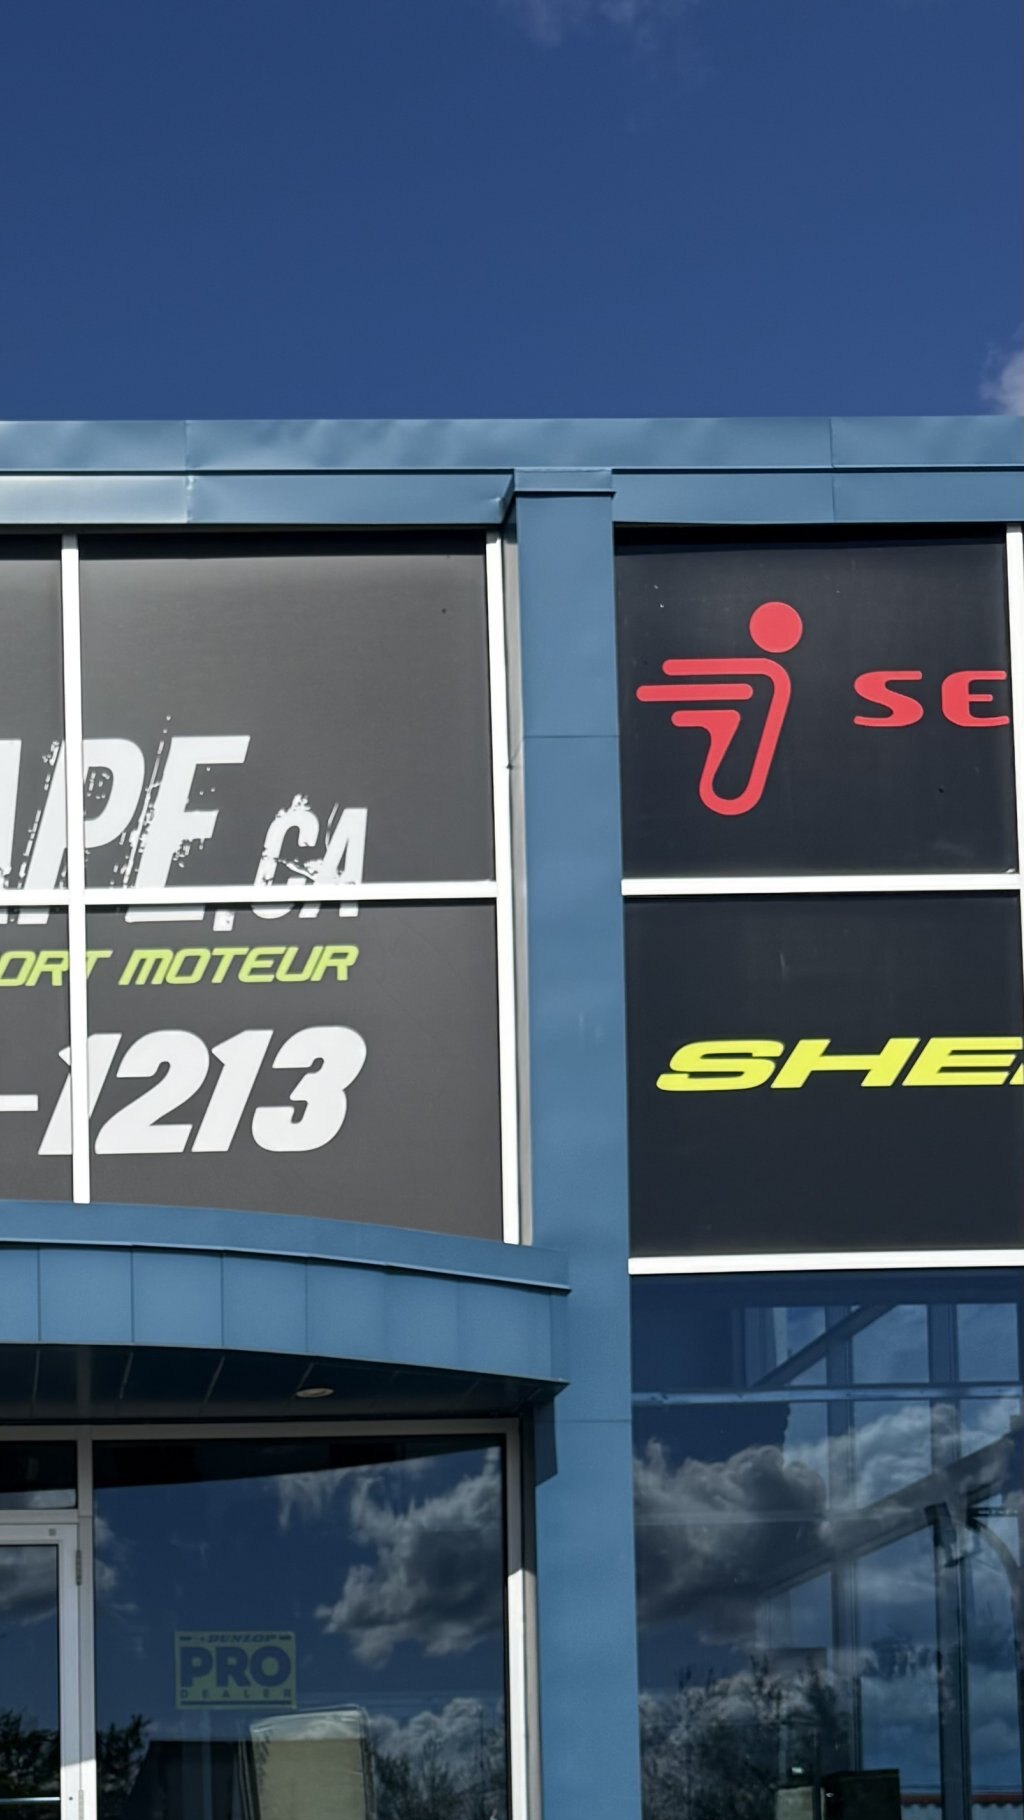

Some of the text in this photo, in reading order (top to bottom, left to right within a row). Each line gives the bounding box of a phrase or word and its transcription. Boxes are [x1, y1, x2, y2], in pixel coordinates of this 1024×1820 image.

[853, 670, 1011, 728] SE
[118, 944, 360, 986] MOTEUR
[656, 1036, 1024, 1092] SHE
[179, 1646, 291, 1687] PRO
[179, 1688, 292, 1699] DEALER
